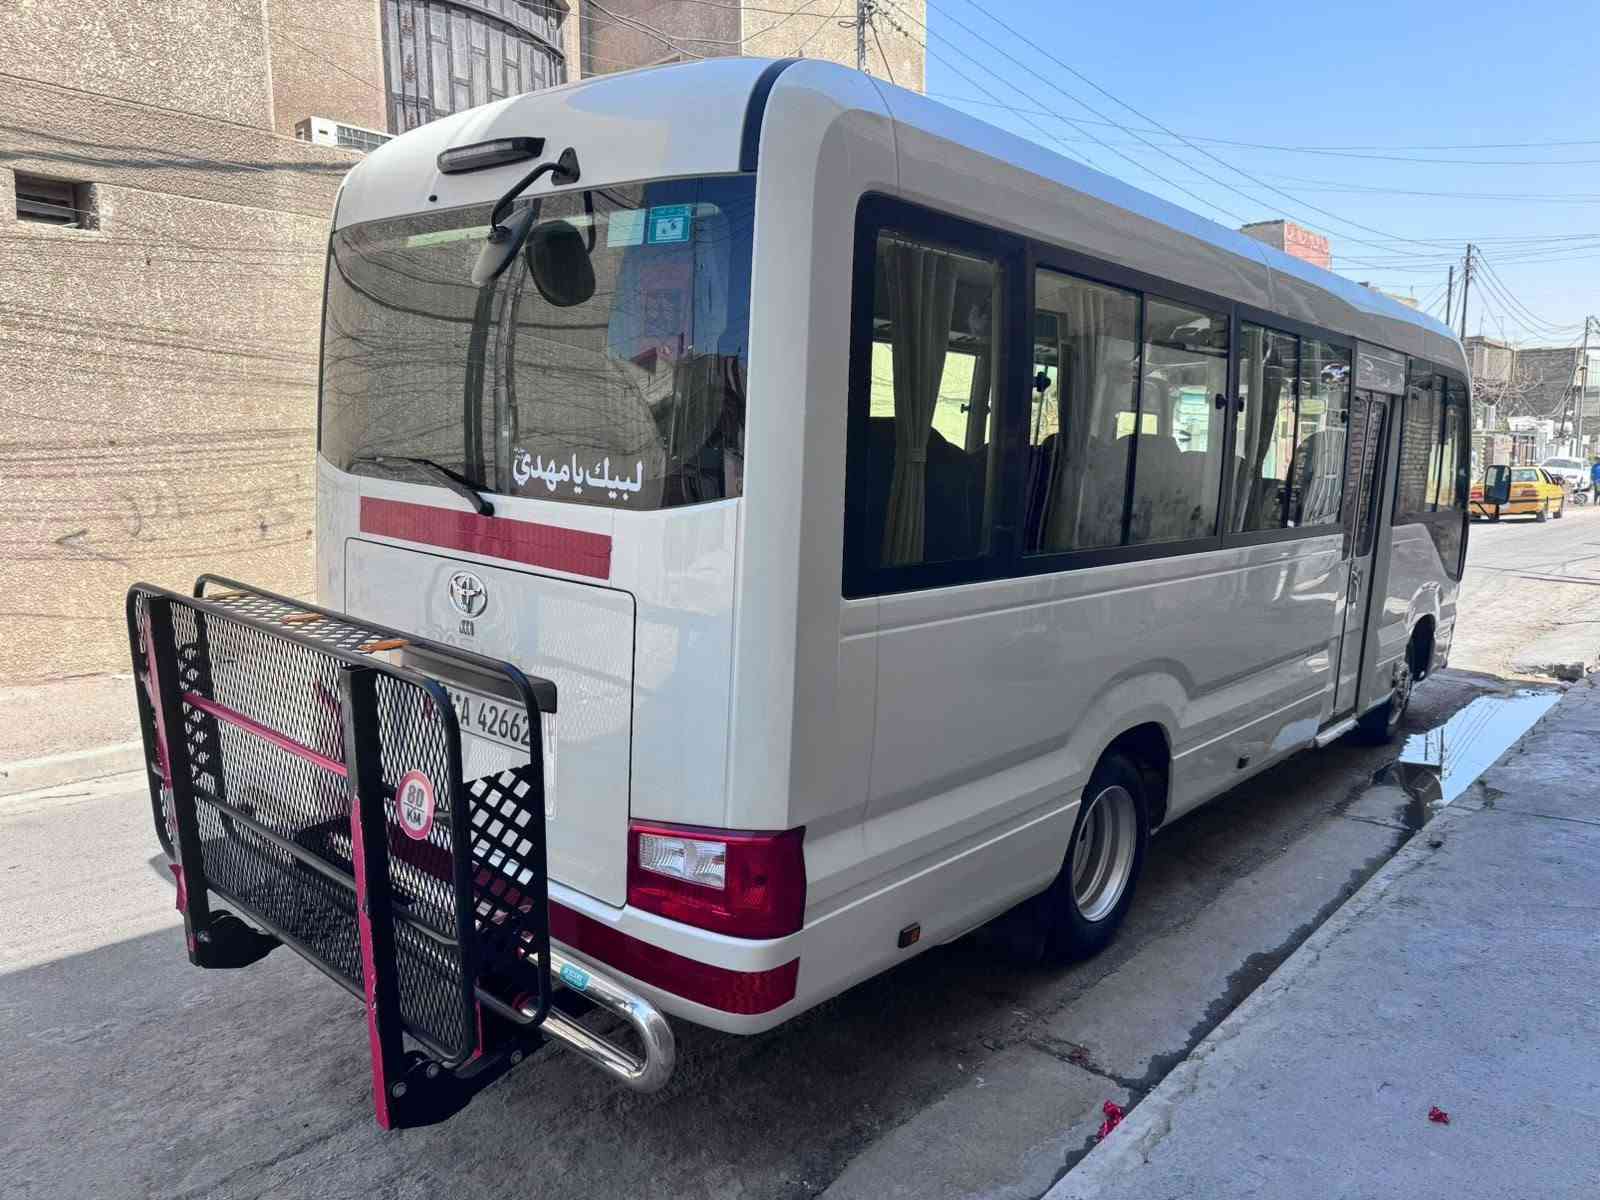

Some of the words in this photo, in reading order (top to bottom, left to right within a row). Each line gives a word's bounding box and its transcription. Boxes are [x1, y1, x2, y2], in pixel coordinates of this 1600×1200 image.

[584, 456, 644, 501] لبيك
[460, 696, 470, 727] A
[477, 702, 530, 747] 42662
[407, 784, 425, 808] 80
[407, 806, 422, 826] KM
